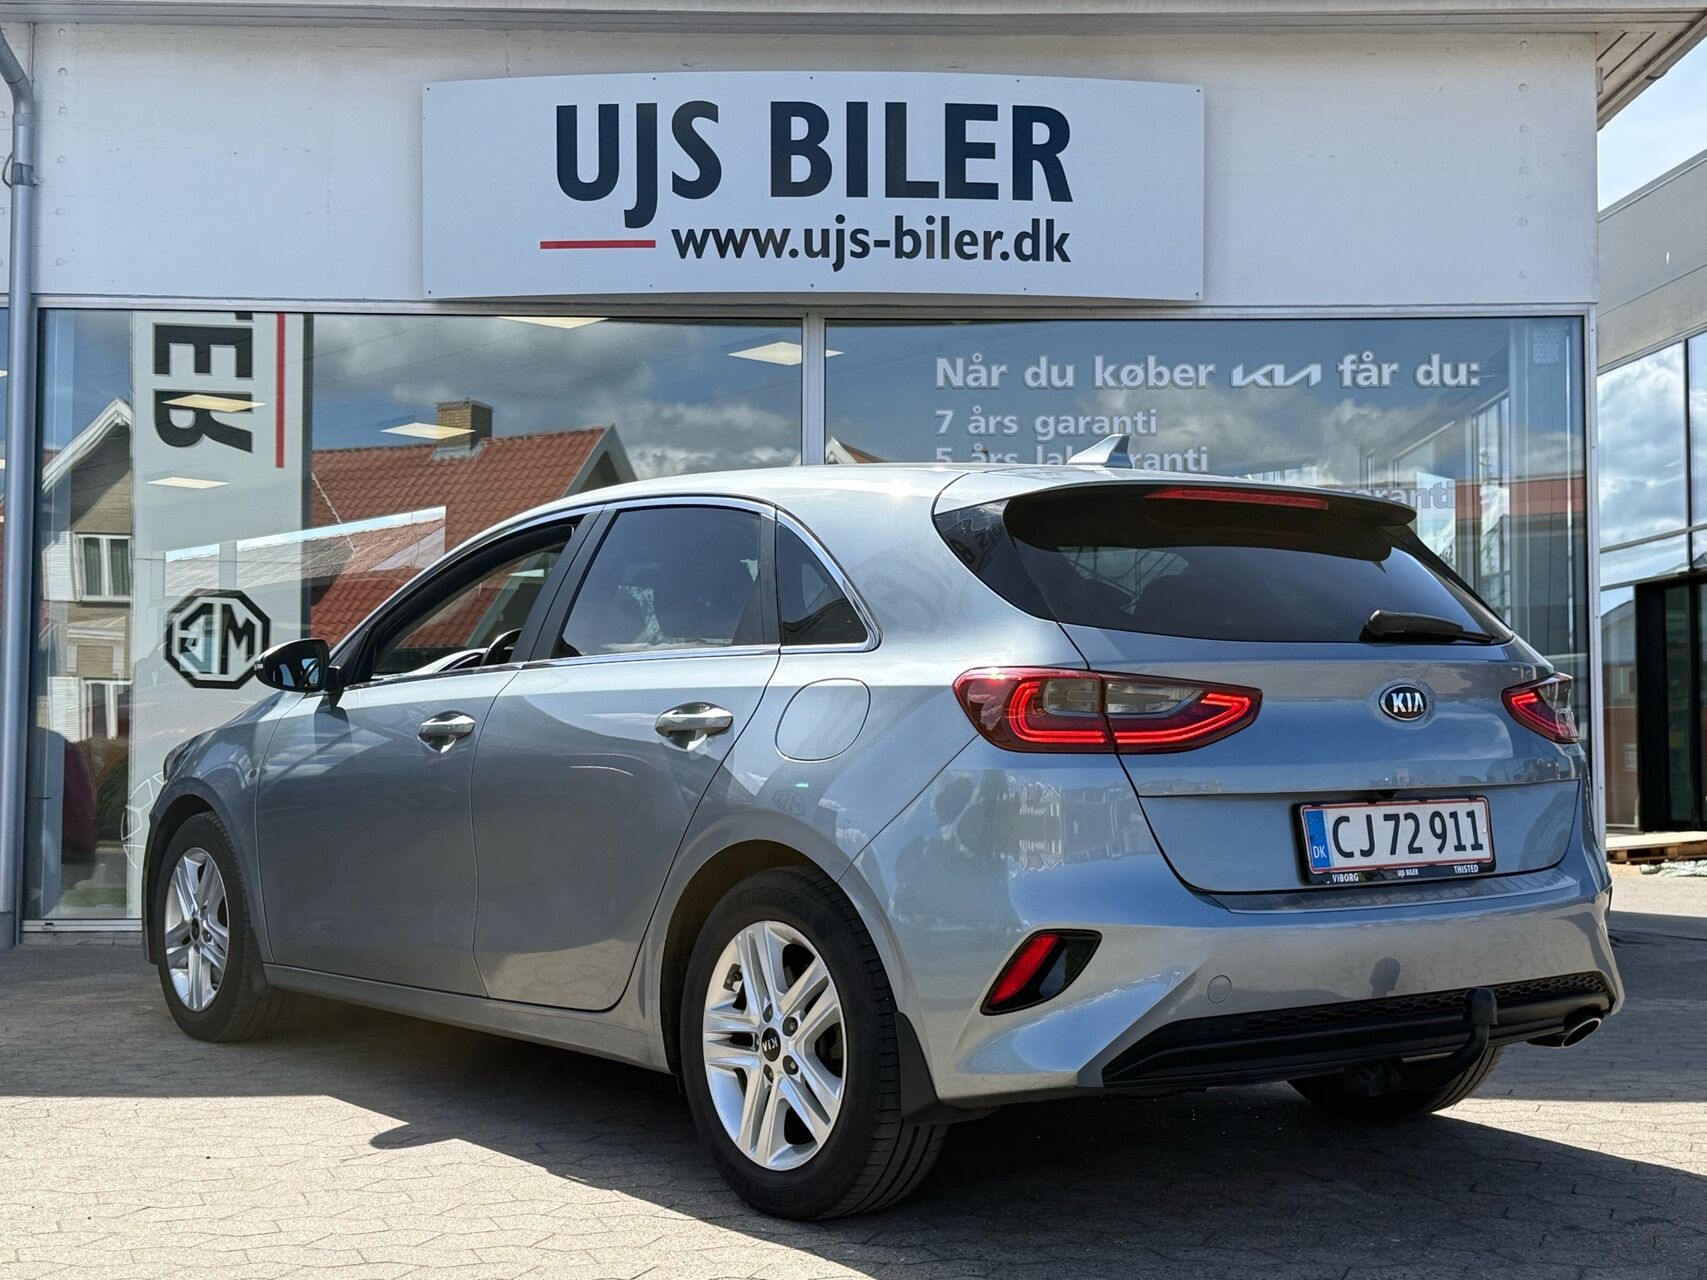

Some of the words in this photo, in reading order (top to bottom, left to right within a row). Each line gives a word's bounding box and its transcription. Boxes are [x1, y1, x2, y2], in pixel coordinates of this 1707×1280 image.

[556, 100, 722, 229] UJS
[770, 100, 1074, 203] BILER
[671, 214, 1072, 272] www.ujs-biler.dk
[936, 353, 1007, 388] Når
[1024, 355, 1075, 388] du
[1093, 355, 1215, 388] køber
[1337, 351, 1399, 387] får
[1415, 353, 1480, 387] du:
[935, 410, 954, 433] 7
[968, 405, 1018, 434] års
[1035, 408, 1157, 441] garanti
[1391, 692, 1425, 713] KIA
[1313, 845, 1327, 859] DK
[1429, 809, 1484, 854] 911
[1332, 873, 1359, 883] VIBORG
[1453, 864, 1479, 874] THISTED
[762, 1037, 779, 1052] KIA
